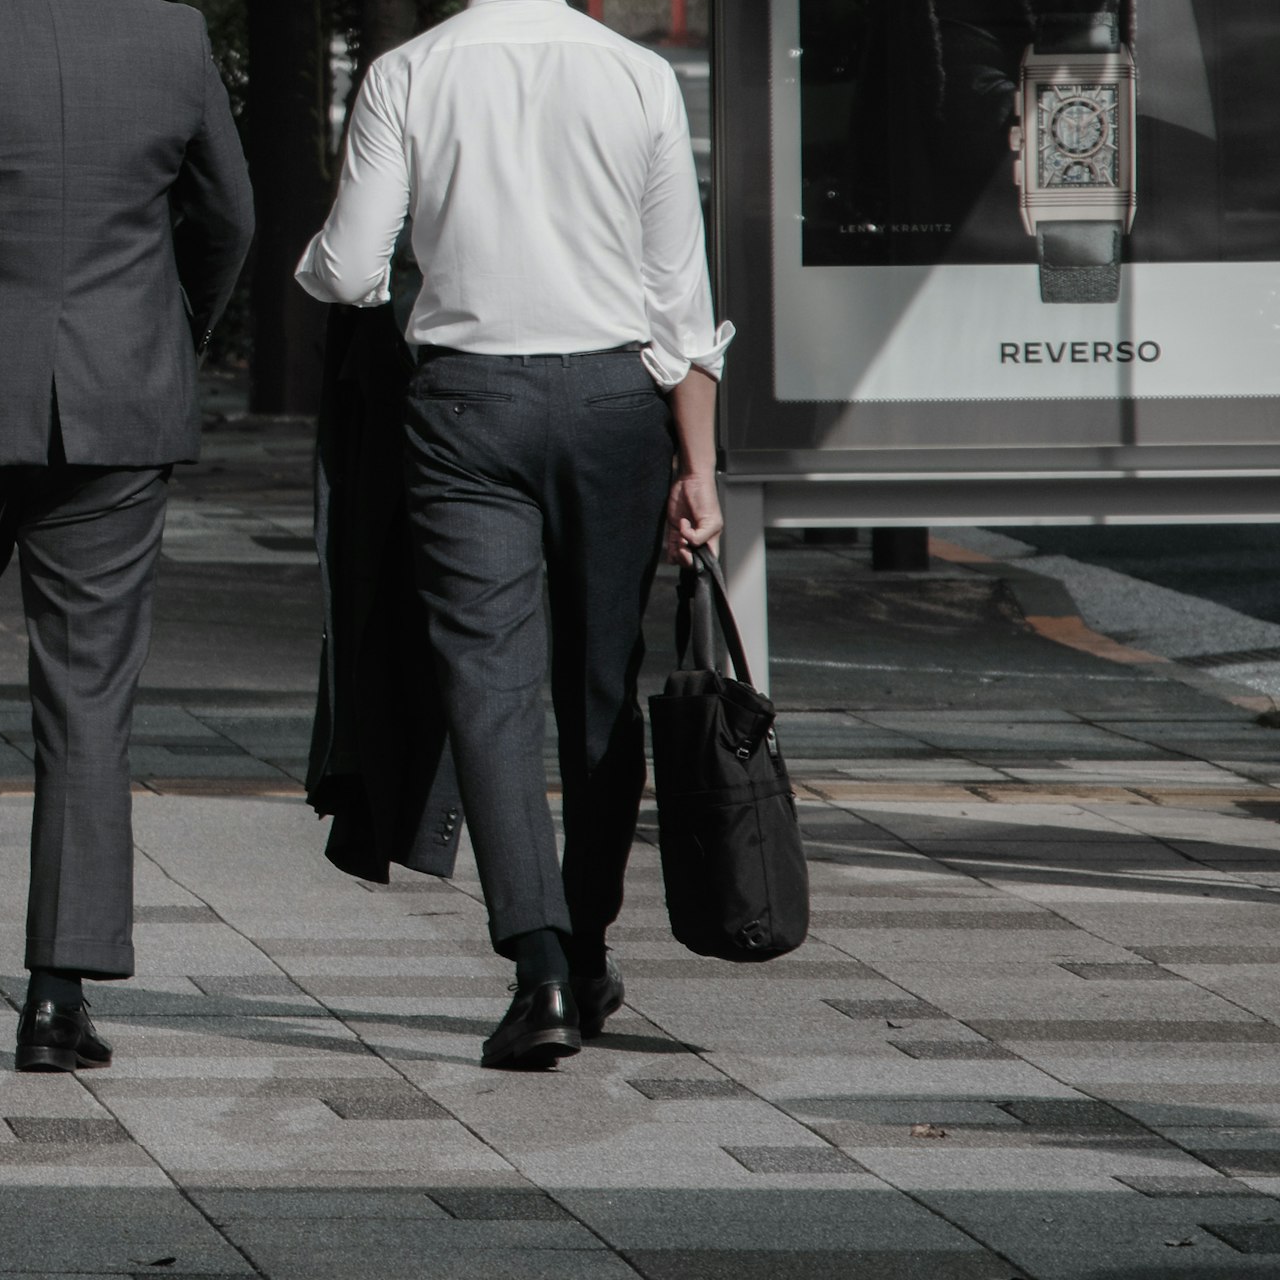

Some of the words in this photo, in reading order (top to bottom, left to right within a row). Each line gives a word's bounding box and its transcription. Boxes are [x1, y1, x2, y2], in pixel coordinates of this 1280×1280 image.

[840, 223, 886, 233] LENY
[891, 223, 952, 232] KRAVITZ
[1000, 341, 1162, 364] REVERSO
